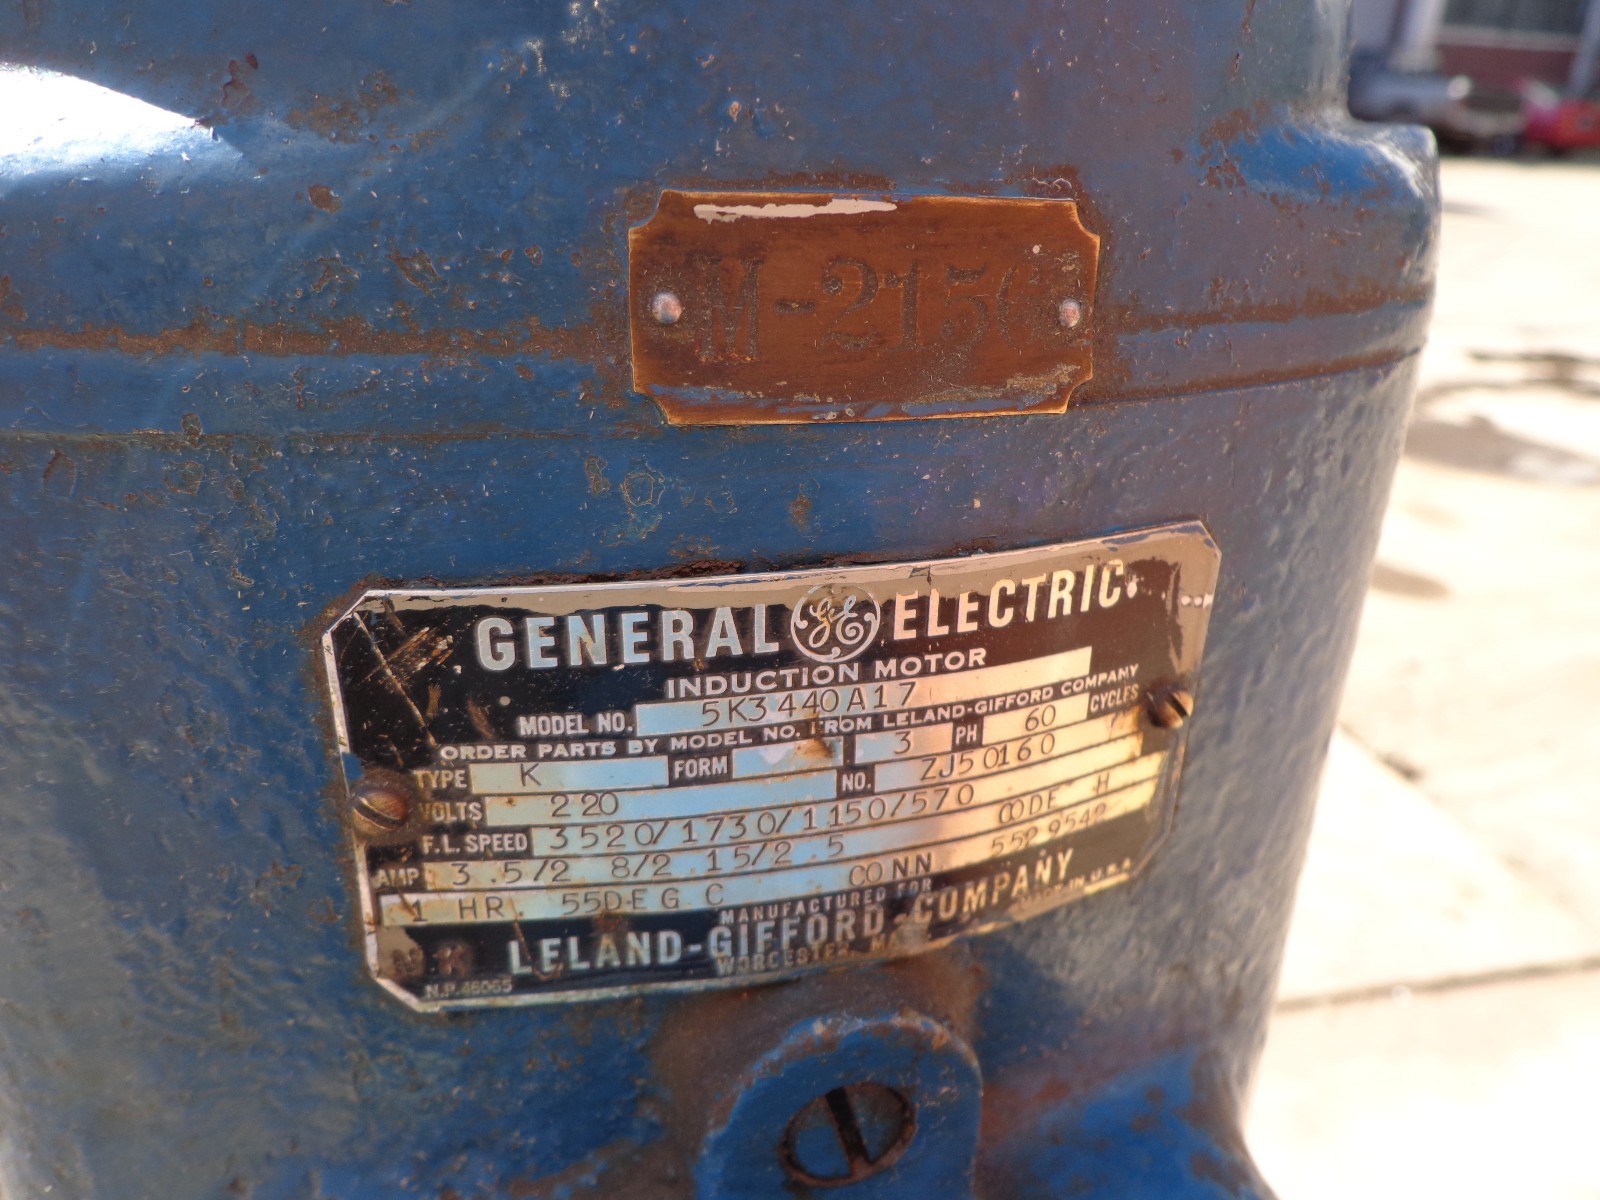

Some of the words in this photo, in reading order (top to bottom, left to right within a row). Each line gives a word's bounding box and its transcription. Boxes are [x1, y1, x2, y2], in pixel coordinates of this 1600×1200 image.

[477, 603, 780, 671] GENERAL
[893, 559, 1124, 641] ELECTRIC
[666, 662, 860, 699] INDUCTION
[874, 647, 987, 679] MOTOR
[413, 769, 468, 790] TYPE
[519, 763, 542, 787] K
[673, 756, 728, 779] FORM
[893, 730, 912, 755] 3
[955, 723, 978, 745] PH
[1025, 704, 1057, 732] 60
[1089, 683, 1139, 714] CYCLES
[440, 744, 527, 761] ORDER
[538, 740, 616, 758] PARTS
[628, 737, 659, 754] BY
[670, 730, 752, 751] MODEL
[763, 724, 801, 741] NO.
[882, 686, 1053, 730] LELAND-GIFFORD
[1060, 664, 1139, 695] COMPANY
[518, 714, 589, 737] MODEL
[597, 711, 634, 733] NO.
[415, 802, 483, 822] VOLTS
[549, 791, 620, 818] 220
[842, 771, 872, 791] NO.
[421, 834, 461, 854] F.L.
[464, 832, 528, 853] SPEED
[375, 867, 420, 887] AMP
[719, 887, 887, 925] MANUFACTURED
[897, 877, 933, 898] FOR
[508, 905, 886, 976] LELAND-GIFFORD
[914, 847, 1075, 923] COMPANY
